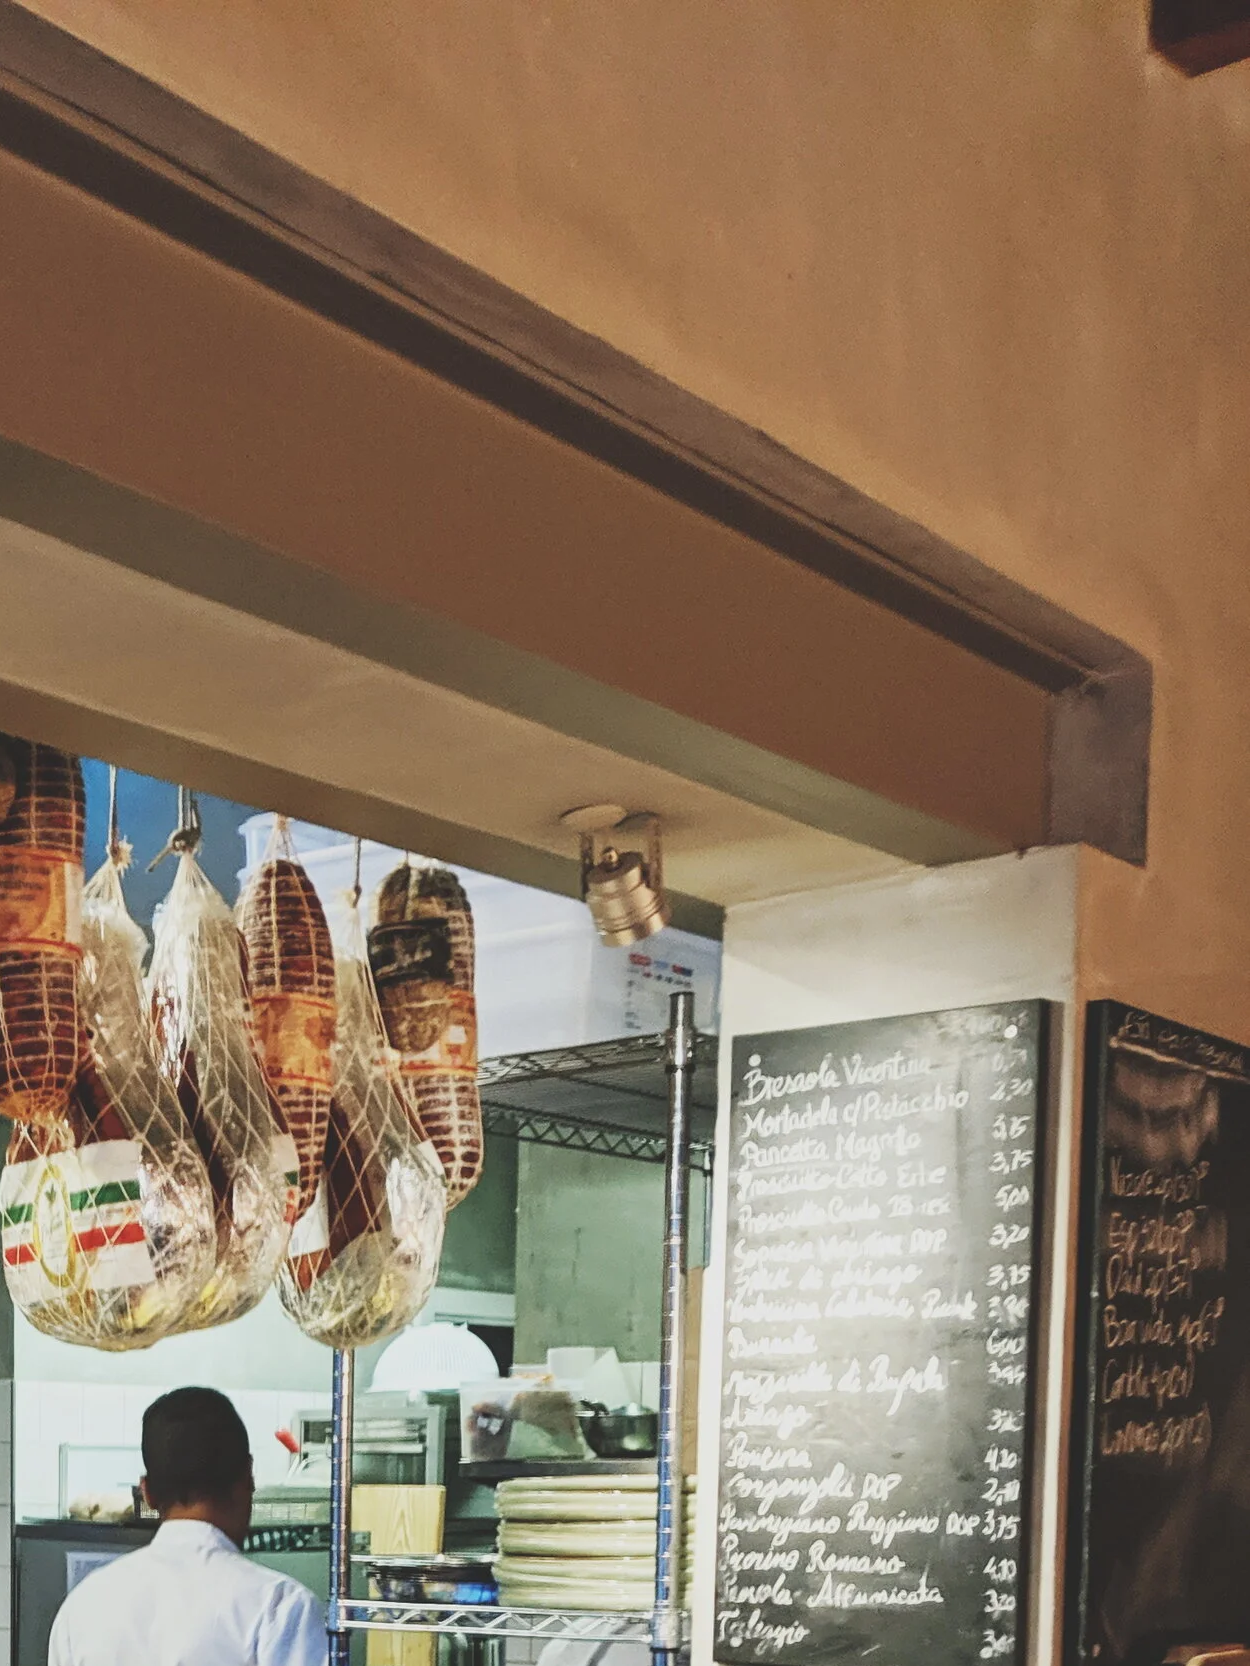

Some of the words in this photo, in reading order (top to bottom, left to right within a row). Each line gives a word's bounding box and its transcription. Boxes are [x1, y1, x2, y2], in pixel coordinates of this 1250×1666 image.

[738, 1053, 841, 1106] Bresaola
[806, 1540, 905, 1574] Romano
[806, 1564, 944, 1608] Affumicata
